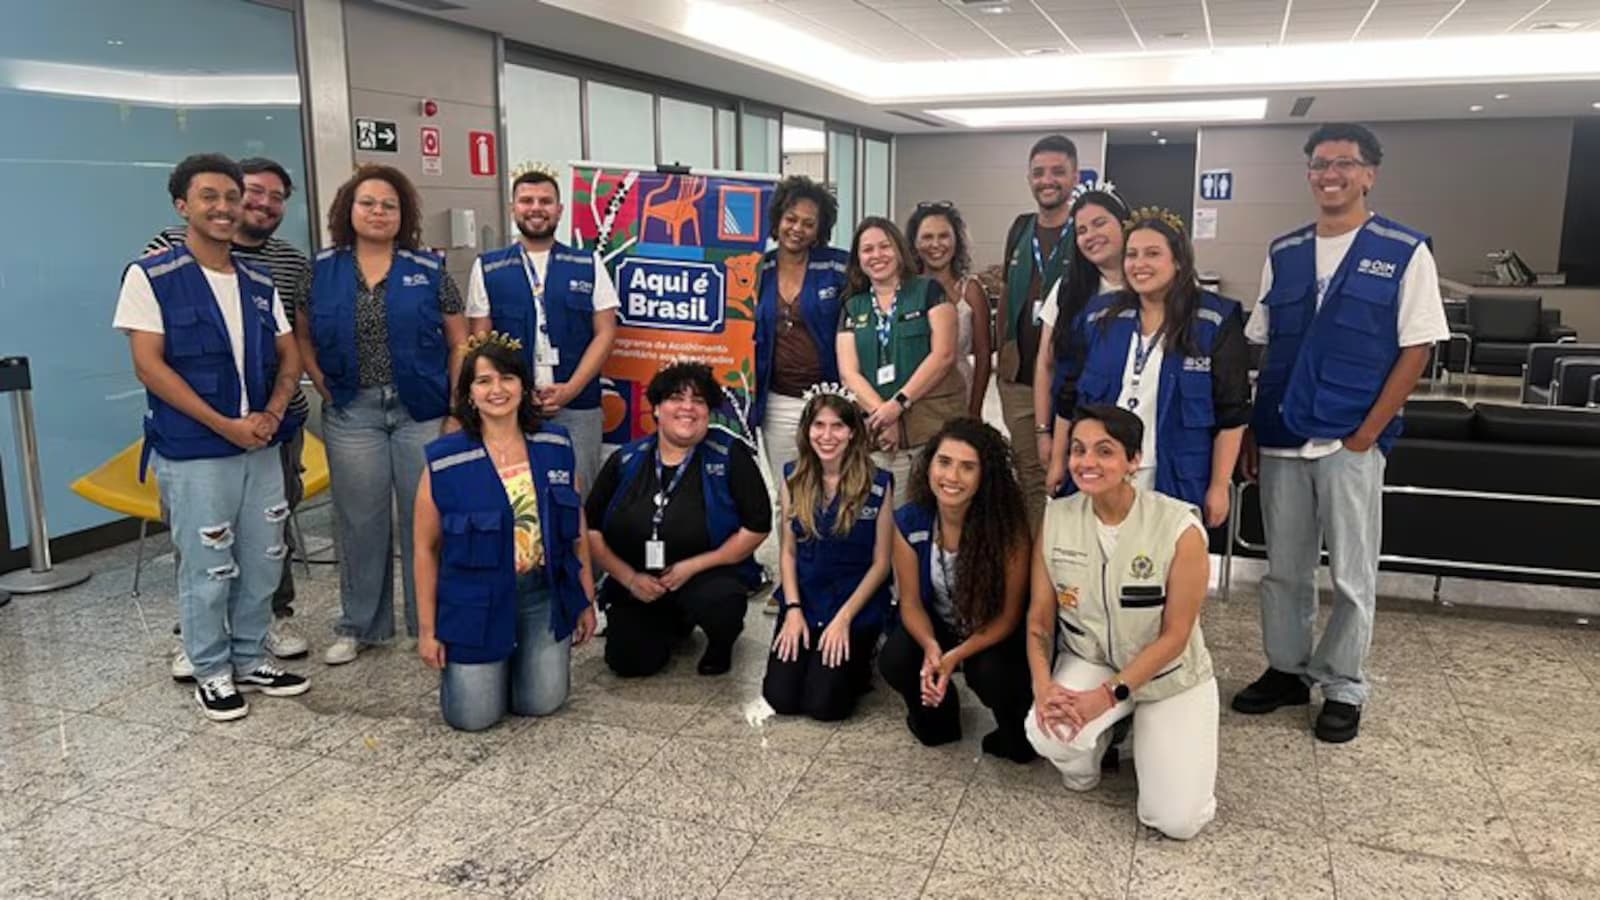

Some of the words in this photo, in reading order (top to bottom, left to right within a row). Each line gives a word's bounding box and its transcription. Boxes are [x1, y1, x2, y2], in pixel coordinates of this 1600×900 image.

[630, 267, 689, 297] Aqui
[692, 272, 709, 295] é
[628, 292, 709, 322] Brasil
[614, 338, 653, 349] rograma
